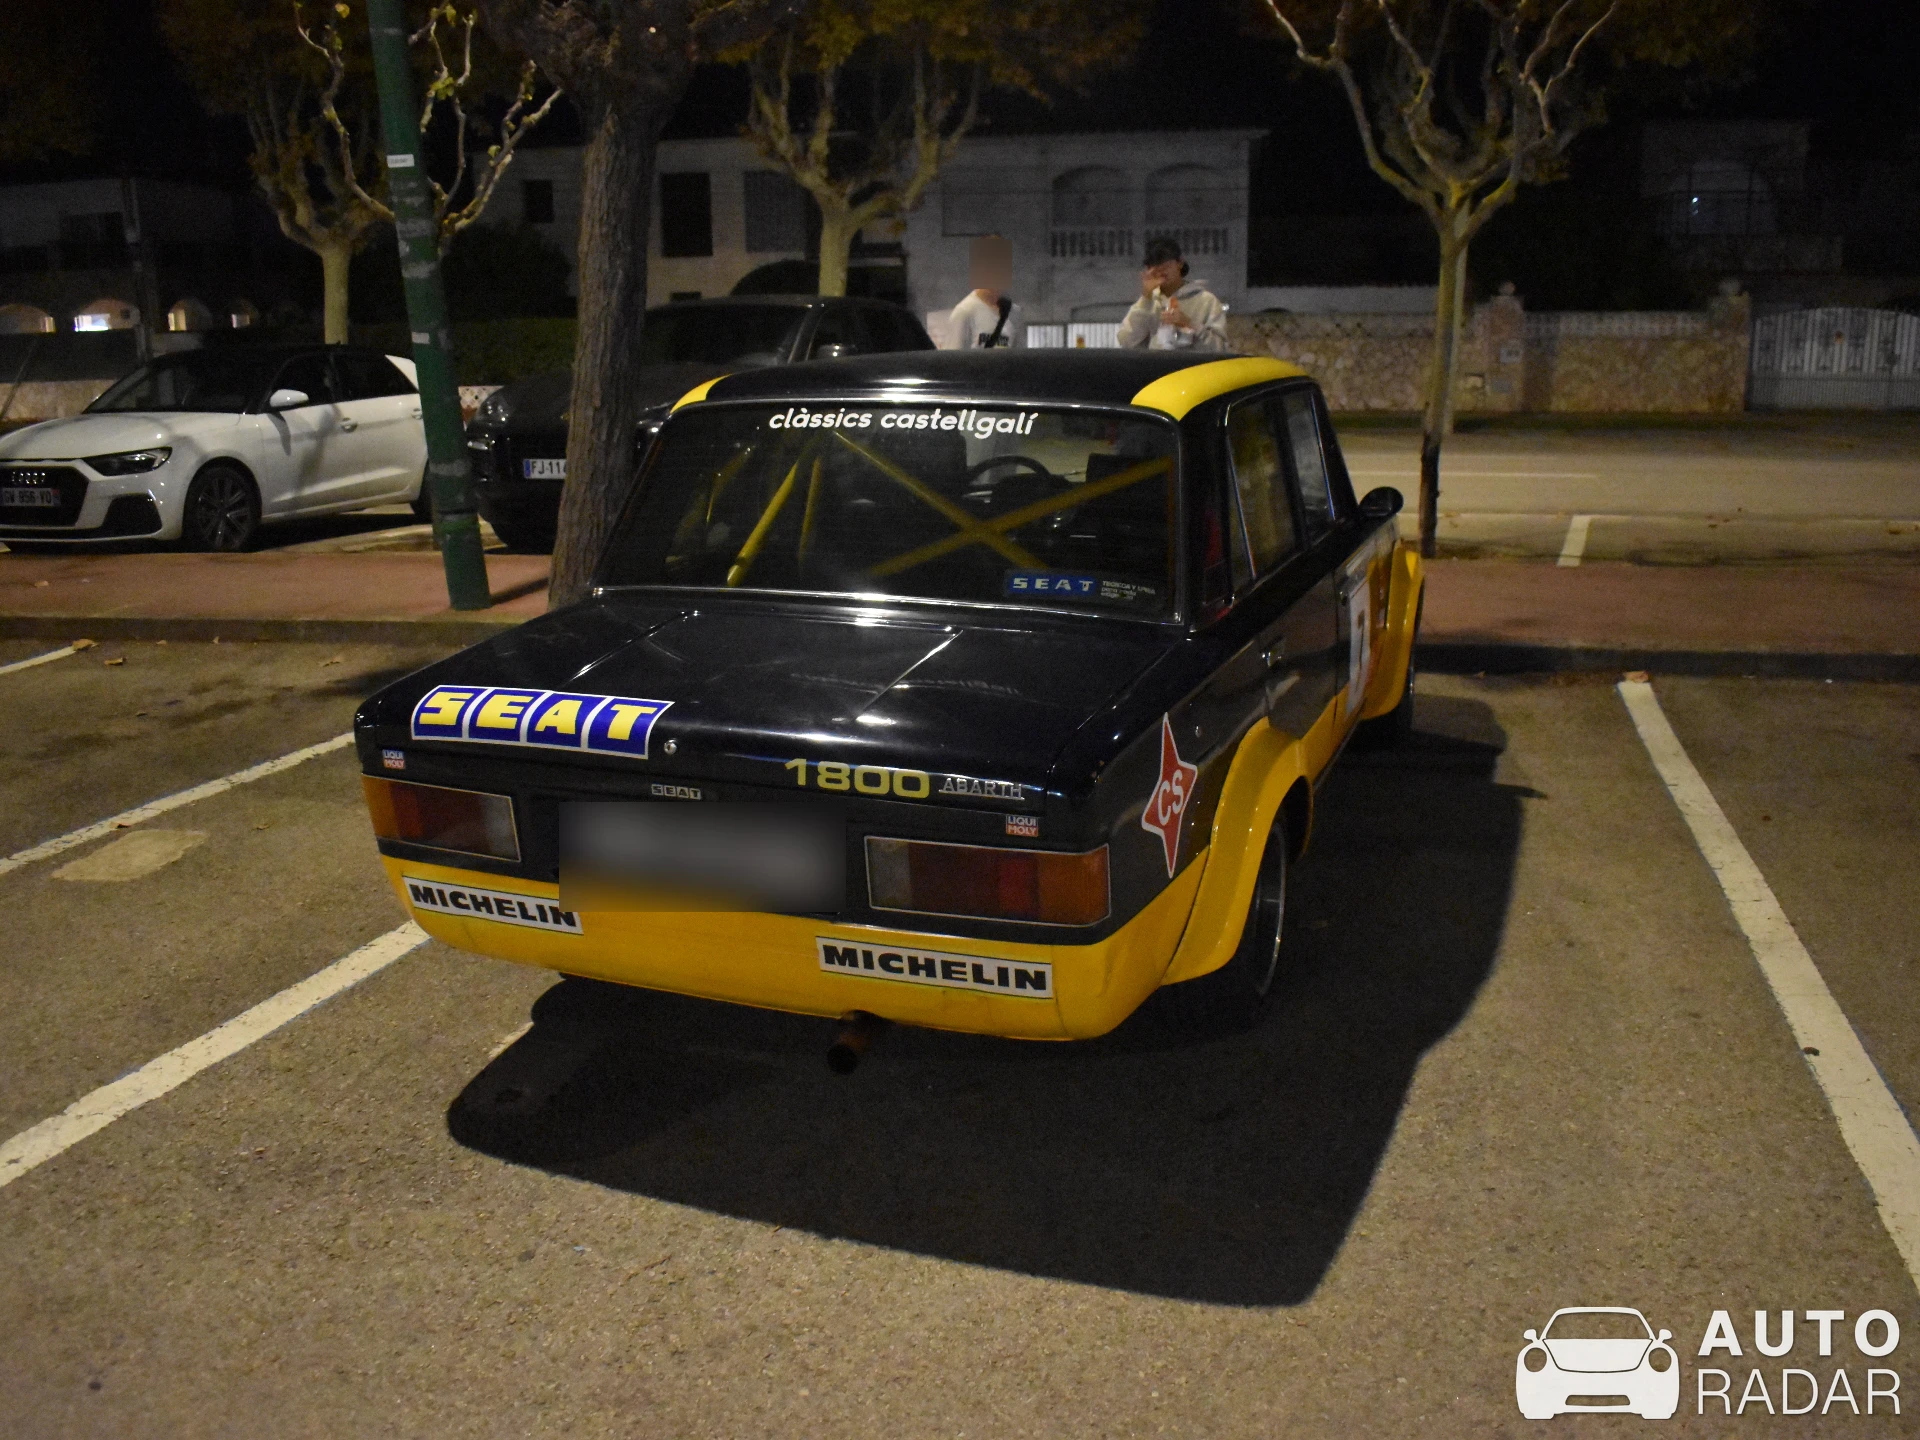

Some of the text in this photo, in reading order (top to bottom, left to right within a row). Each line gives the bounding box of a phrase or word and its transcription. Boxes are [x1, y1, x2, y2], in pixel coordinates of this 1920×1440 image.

[768, 407, 1039, 440] clàssics castellgalí
[1012, 577, 1094, 592] SEAT
[418, 691, 658, 741] SEAT
[651, 783, 702, 800] SEAT
[784, 758, 930, 798] 1800
[940, 777, 1023, 800] ABARTH
[1157, 769, 1184, 826] CS
[1007, 815, 1038, 826] LIQUI
[1007, 824, 1038, 835] MOLY
[408, 883, 578, 928] MICHELIN
[822, 944, 1047, 991] MICHELIN
